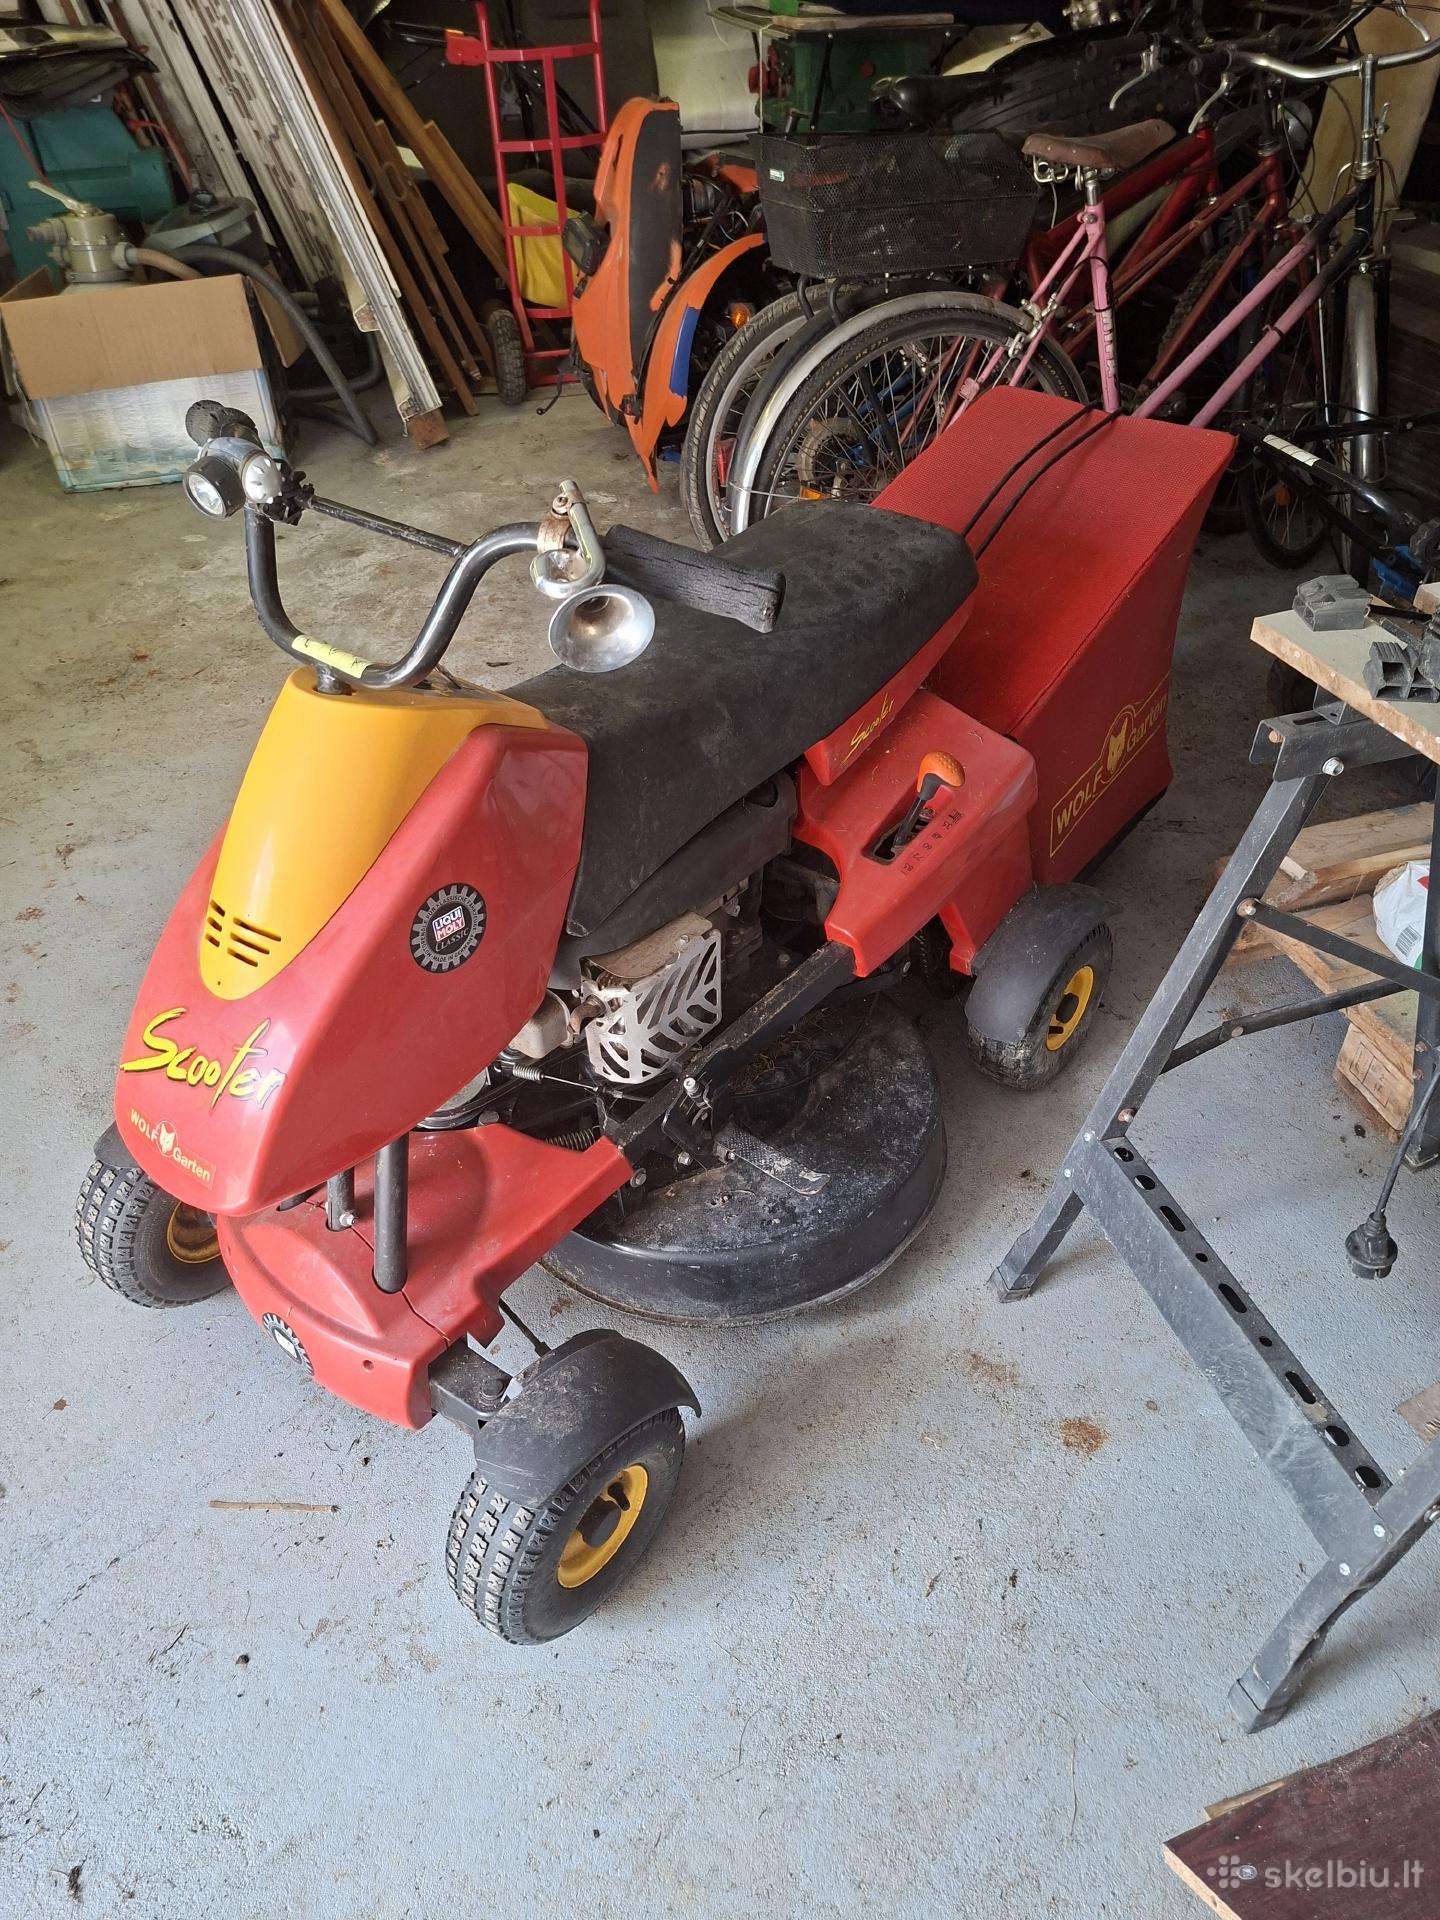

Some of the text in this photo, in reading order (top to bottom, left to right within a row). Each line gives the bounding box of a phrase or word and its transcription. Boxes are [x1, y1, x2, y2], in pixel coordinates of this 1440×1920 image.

[1056, 765, 1103, 835] WOLF
[435, 908, 462, 929] LIQUI
[436, 919, 465, 940] MOLY
[436, 928, 469, 952] CLASSIC
[120, 1007, 288, 1110] Scooter
[130, 1108, 212, 1181] WOLF Garten
